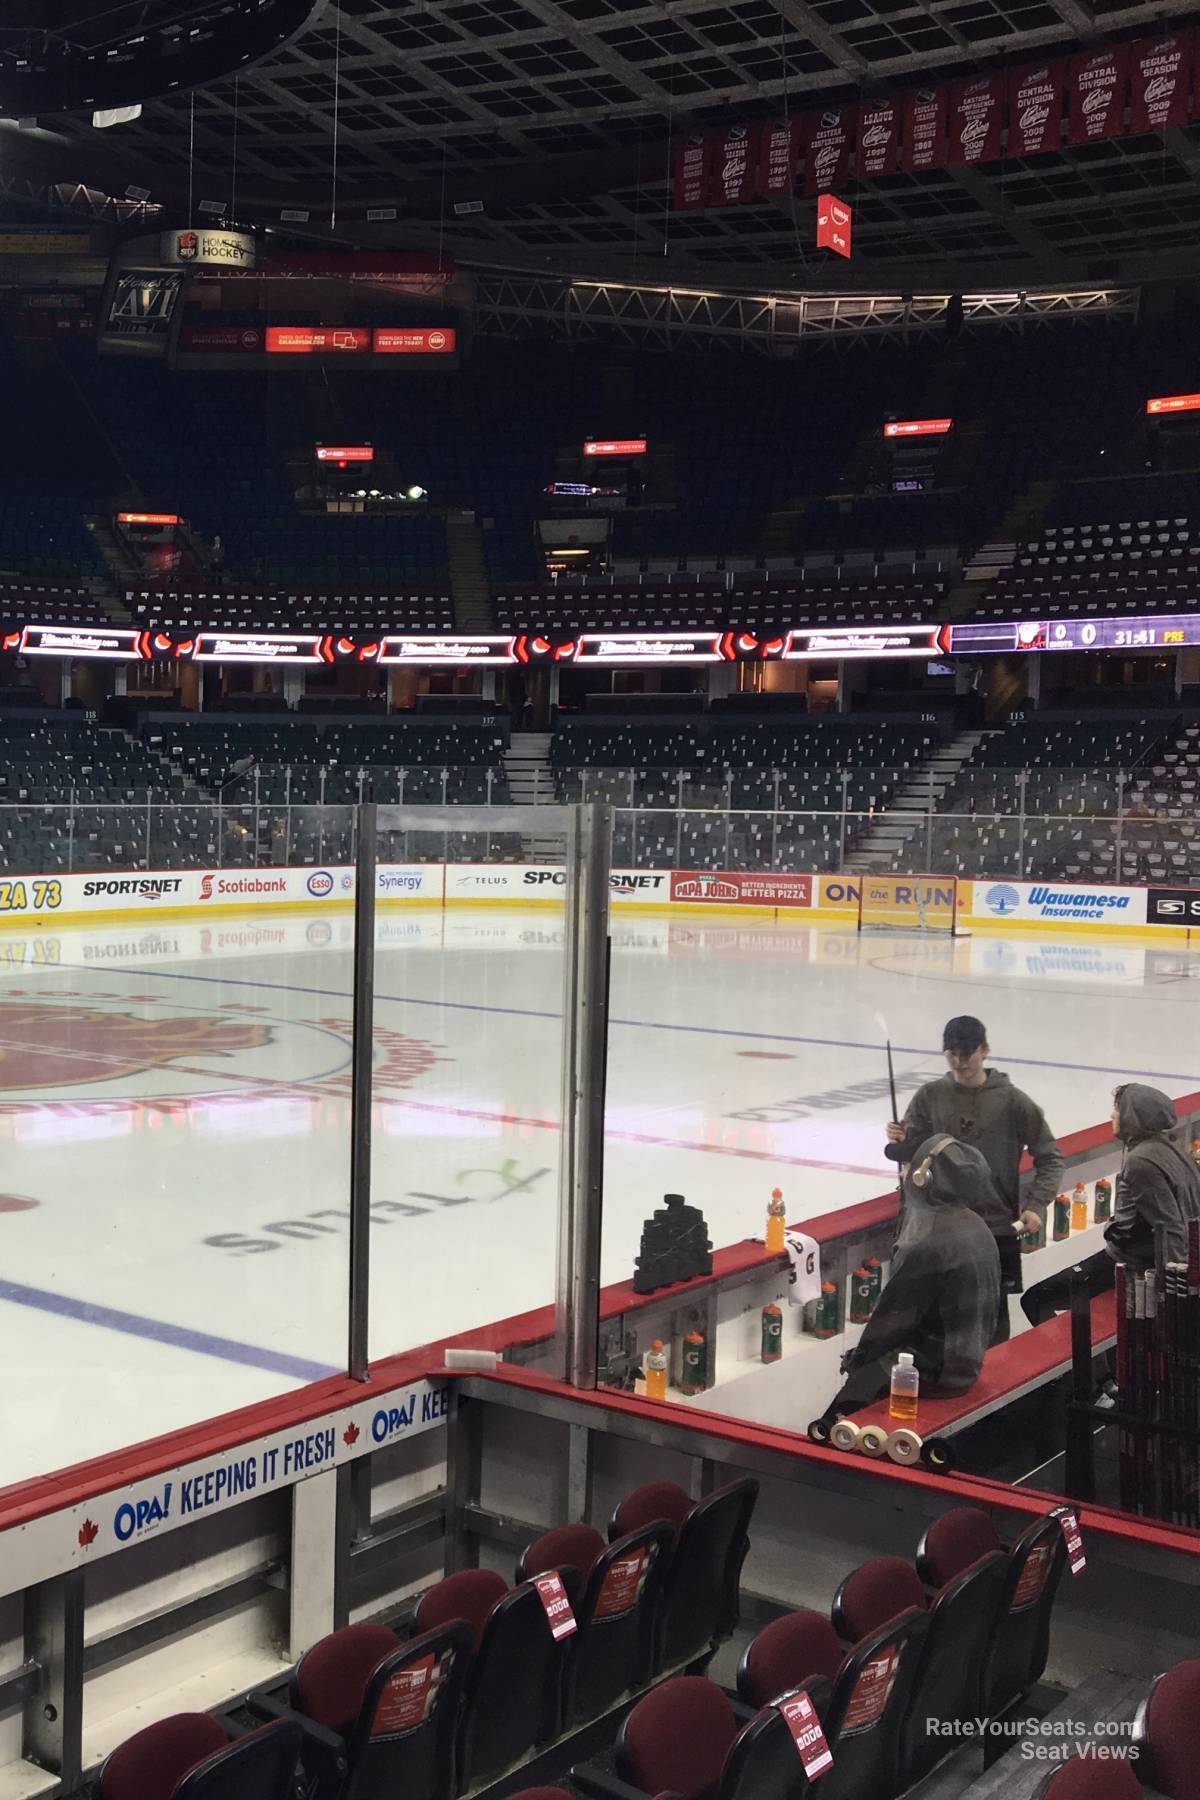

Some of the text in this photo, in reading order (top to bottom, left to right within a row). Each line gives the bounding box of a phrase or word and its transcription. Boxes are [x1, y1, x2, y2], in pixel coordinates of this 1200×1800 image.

[1140, 52, 1181, 69] REGULAR
[1078, 66, 1117, 81] CENTRAL
[1143, 63, 1178, 78] SEASON
[1018, 84, 1054, 98] CENTRAL
[1079, 75, 1117, 91] DIVISION
[1017, 93, 1054, 108] DIVISION
[202, 238, 228, 247] HOME
[202, 247, 245, 259] HOCKEY
[115, 288, 172, 317] AVI
[1056, 623, 1185, 645] 0 0 31:41 PRE
[1050, 640, 1073, 648] SHOTS
[1010, 712, 1025, 720] 115
[83, 879, 182, 897] SPORTSNET
[218, 876, 286, 894] Scotiabank
[312, 879, 329, 888] Esso
[379, 874, 422, 890] Synergy
[677, 882, 701, 897] PAPA
[33, 880, 61, 908] 73
[742, 889, 775, 898] BETTER
[826, 884, 953, 906] ON the RUN
[1028, 887, 1130, 909] Wawanesa
[1042, 904, 1104, 919] Insurance
[203, 1192, 477, 1255] TELUS
[372, 1394, 416, 1443] OPA!
[113, 1427, 336, 1542] OPA! KEEPING IT FRESH
